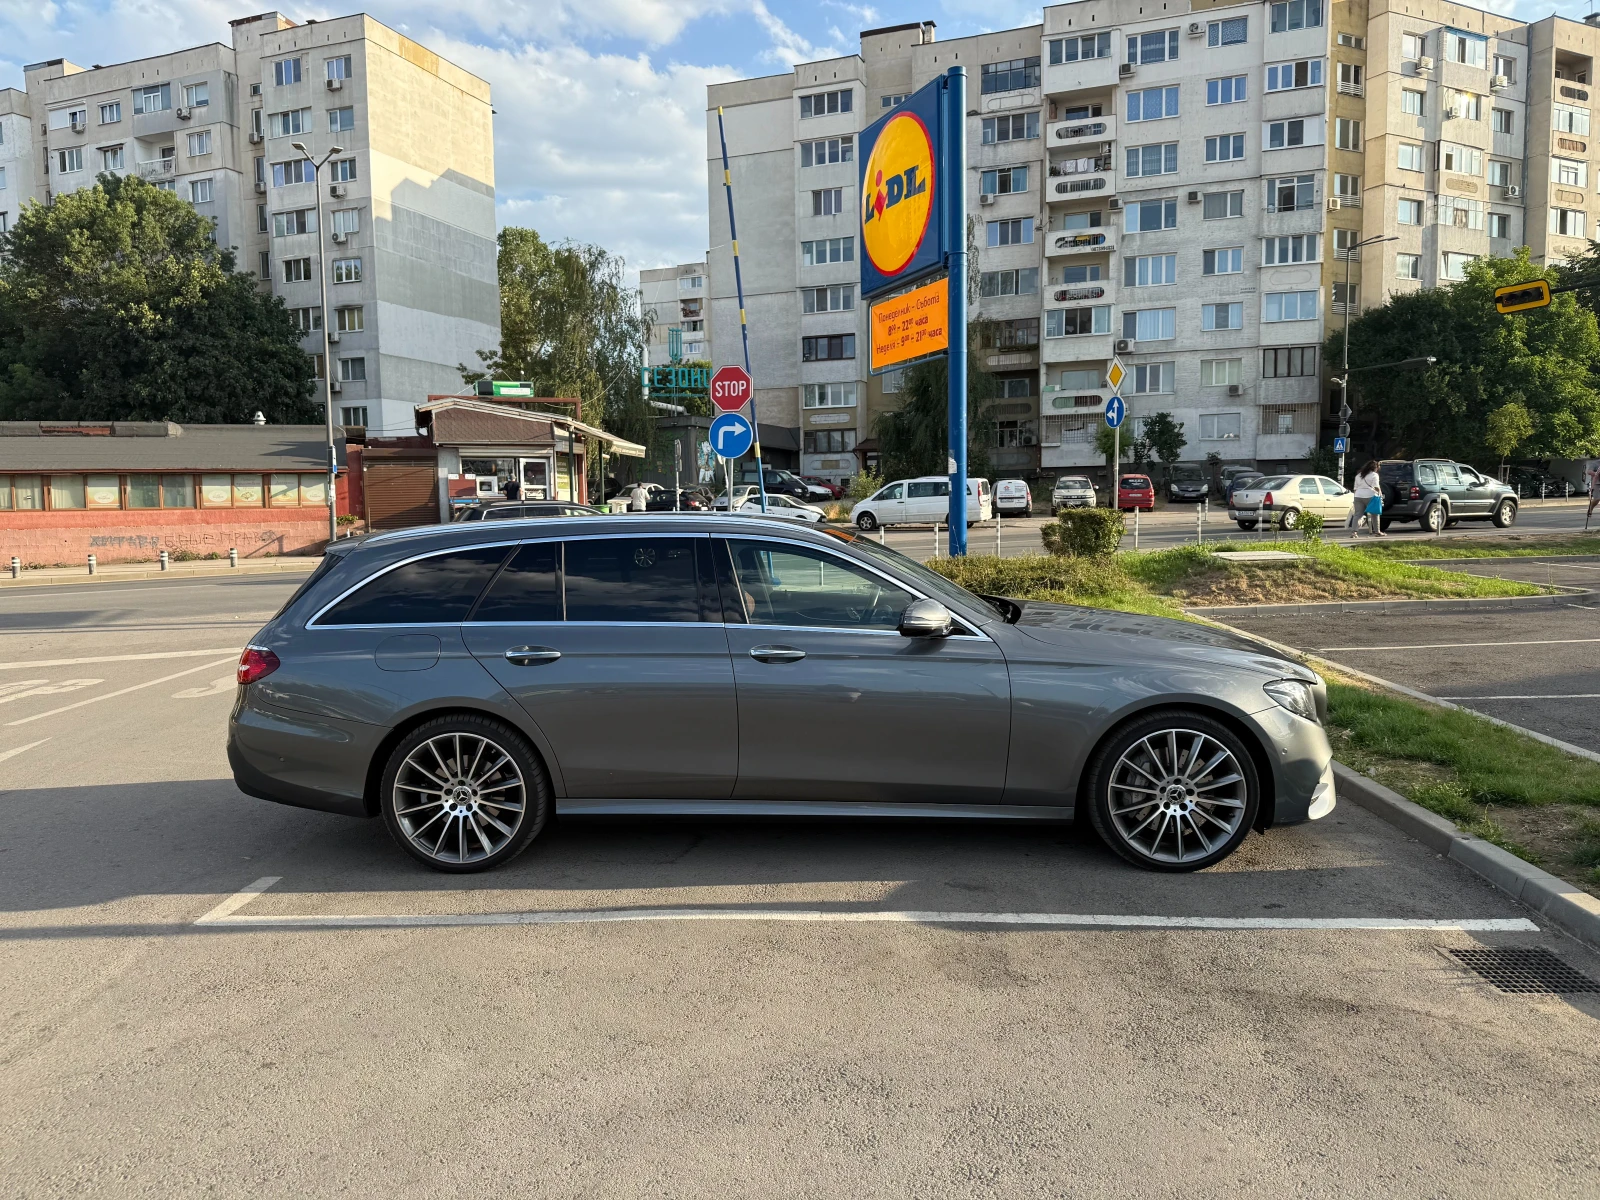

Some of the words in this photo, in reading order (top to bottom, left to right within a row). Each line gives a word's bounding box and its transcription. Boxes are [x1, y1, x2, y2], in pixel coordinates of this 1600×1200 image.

[878, 303, 911, 323] Понеделник
[916, 295, 940, 310] Събота
[915, 315, 929, 327] часа
[876, 342, 896, 355] Неделя
[928, 327, 943, 338] часа
[715, 380, 747, 397] STOP
